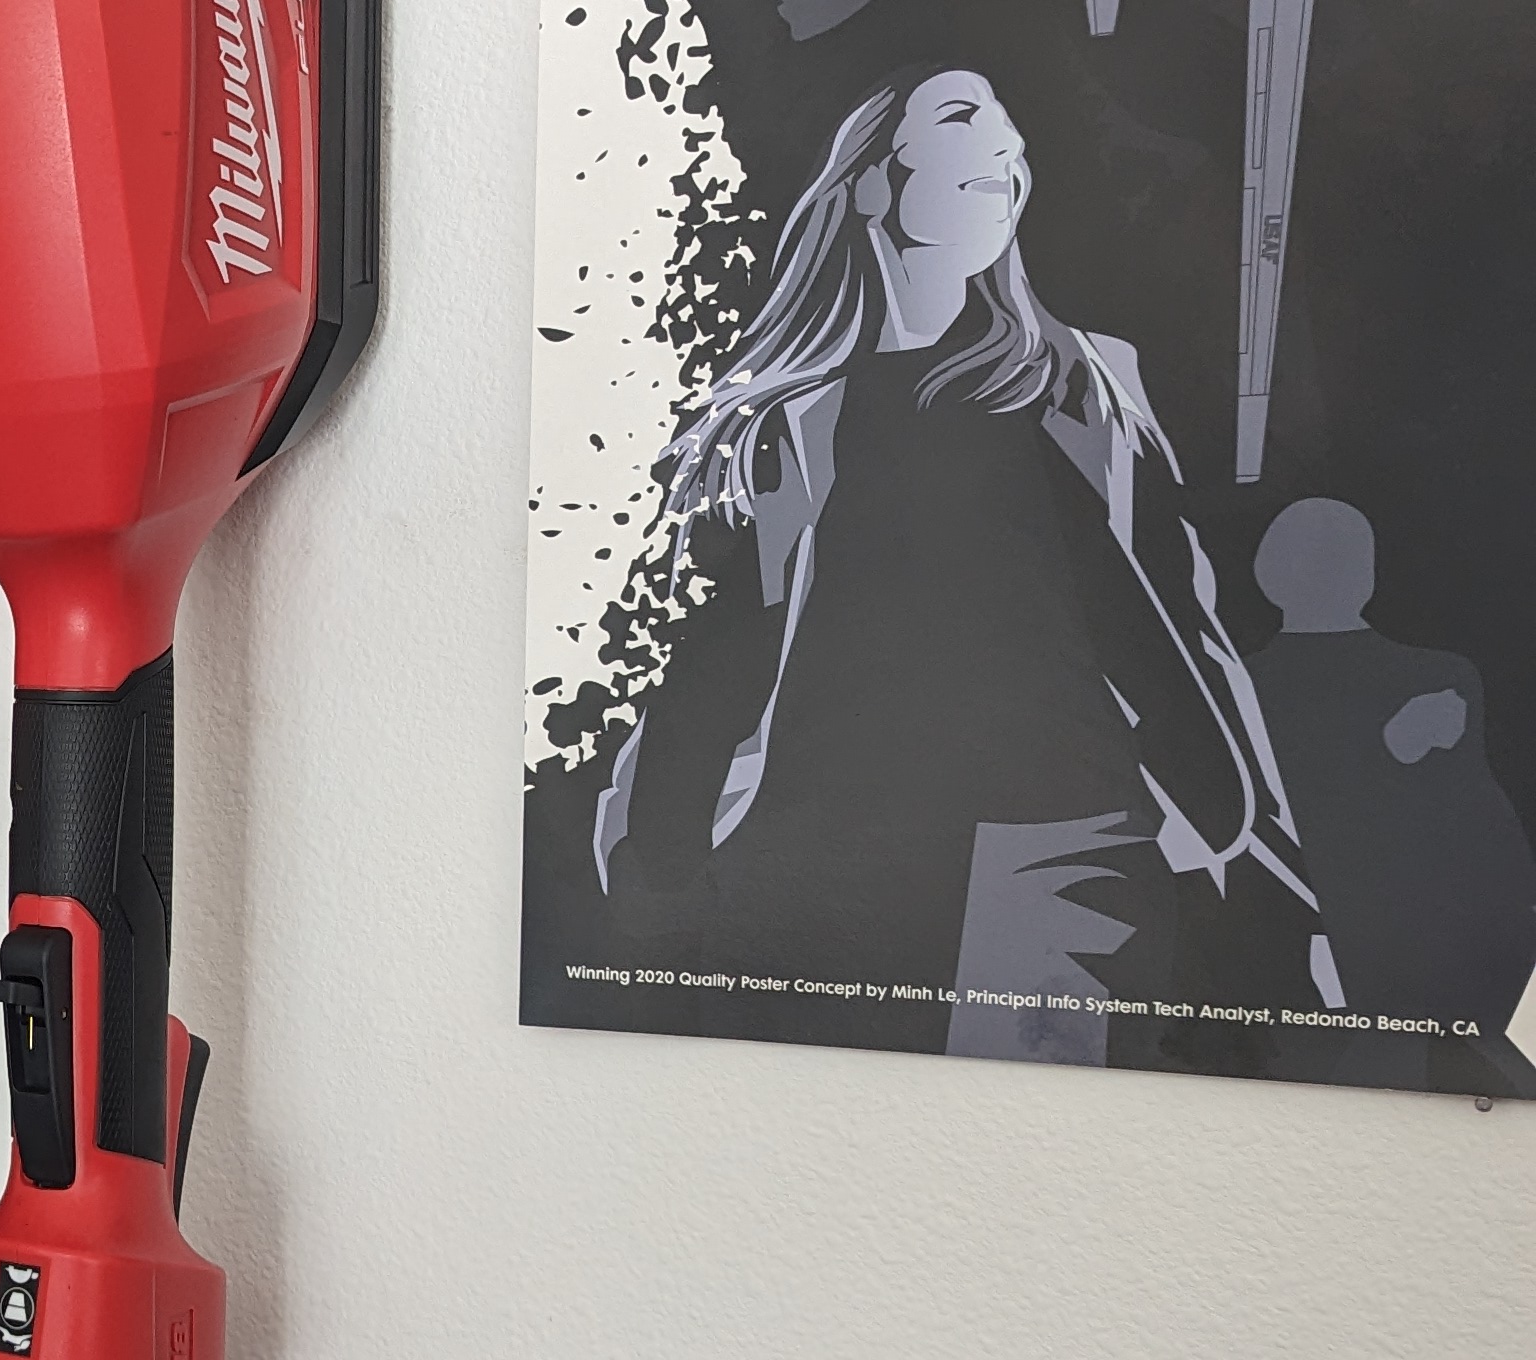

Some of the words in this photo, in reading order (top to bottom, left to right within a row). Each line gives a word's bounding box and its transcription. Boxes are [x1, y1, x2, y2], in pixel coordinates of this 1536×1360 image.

[566, 965, 630, 986] Winning
[635, 969, 675, 985] 2020
[679, 971, 736, 992] Quality
[741, 975, 790, 992] Poster
[793, 978, 862, 999] Concept
[866, 983, 888, 1001] by
[891, 984, 933, 1001] Minh
[938, 987, 962, 1005] Le,
[966, 989, 1042, 1011] Principal
[1047, 994, 1081, 1010] Info
[1085, 996, 1148, 1016] System
[1153, 1001, 1194, 1017] Tech
[1199, 1004, 1275, 1025] Analyst,
[1281, 1009, 1371, 1029] Redondo
[1377, 1015, 1445, 1037] Beach,
[1452, 1020, 1480, 1036] CA
